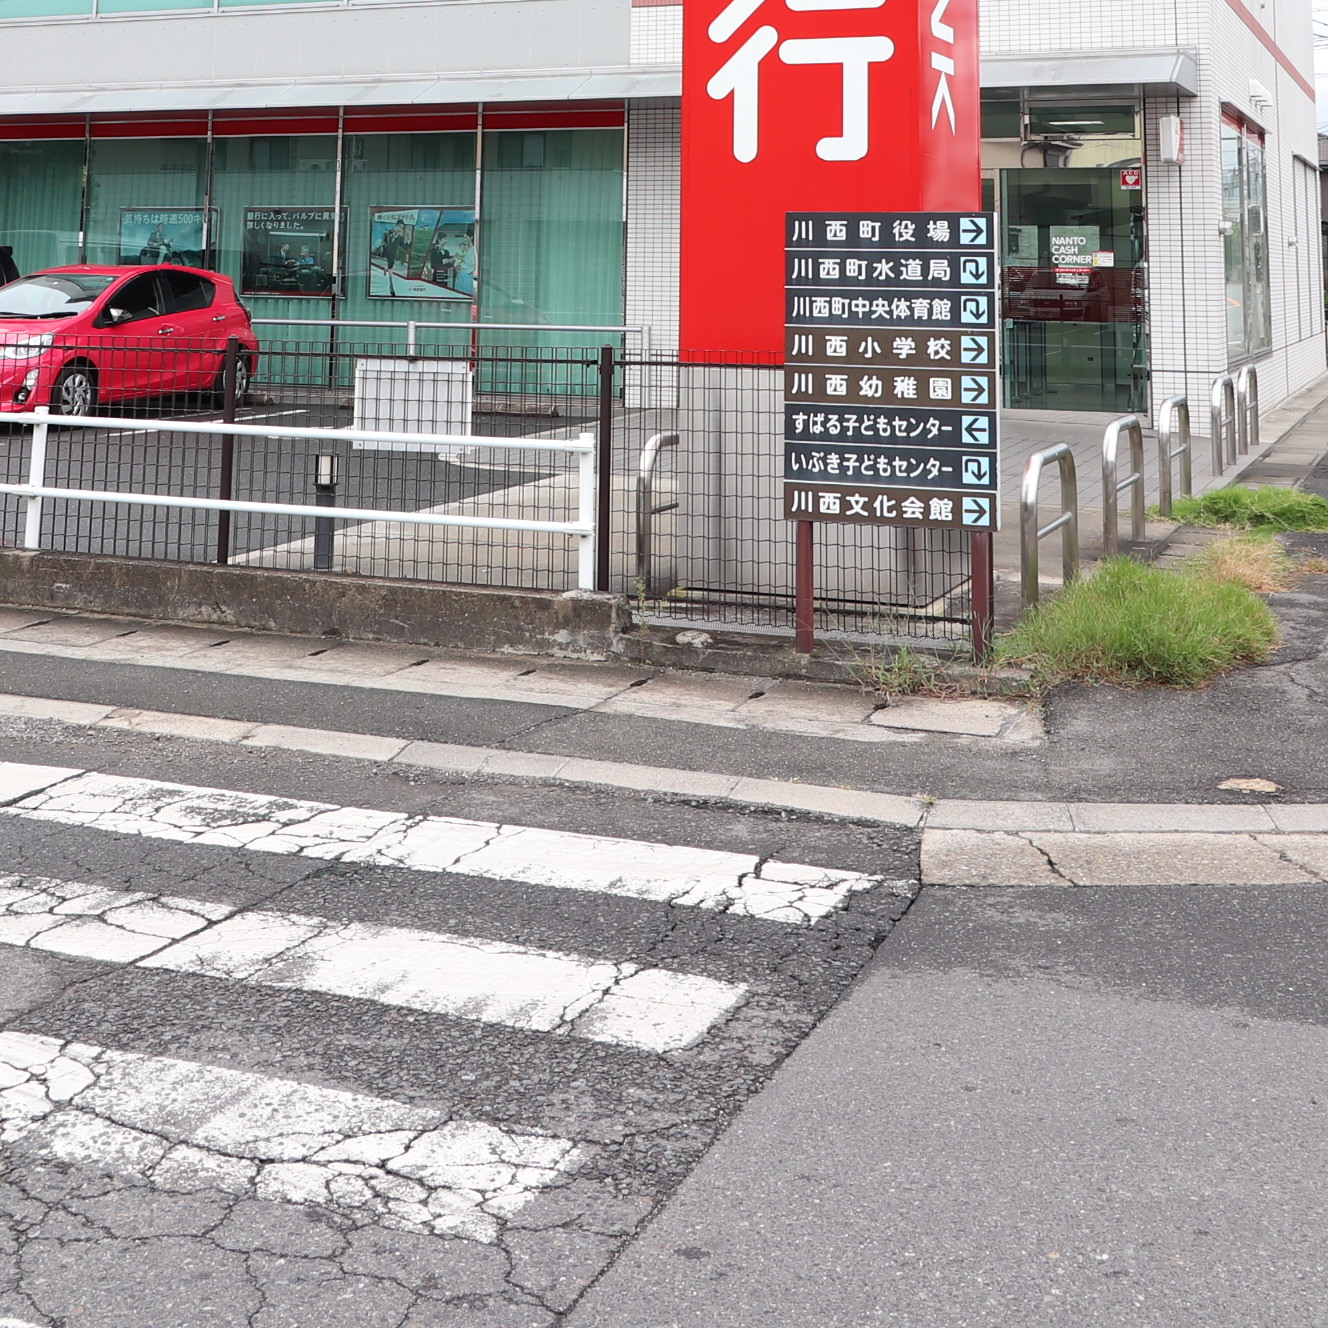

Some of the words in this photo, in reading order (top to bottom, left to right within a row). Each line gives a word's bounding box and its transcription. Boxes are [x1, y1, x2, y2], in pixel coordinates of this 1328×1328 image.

[123, 213, 204, 225] 気持ちは時速500キ
[791, 219, 952, 242] 川西町役場
[1052, 236, 1086, 245] NANTO
[1052, 245, 1078, 254] CASH
[790, 258, 952, 282] 川西町水道局
[1052, 255, 1092, 264] CORNER
[791, 296, 953, 321] 川西町中央体育館
[790, 334, 953, 361] 川西小学校
[790, 372, 953, 401] 川西幼稚園
[791, 412, 953, 439] すばる子どもセンター
[791, 452, 953, 480] いぶき子どもセンター
[790, 490, 953, 522] 川西文化会館
